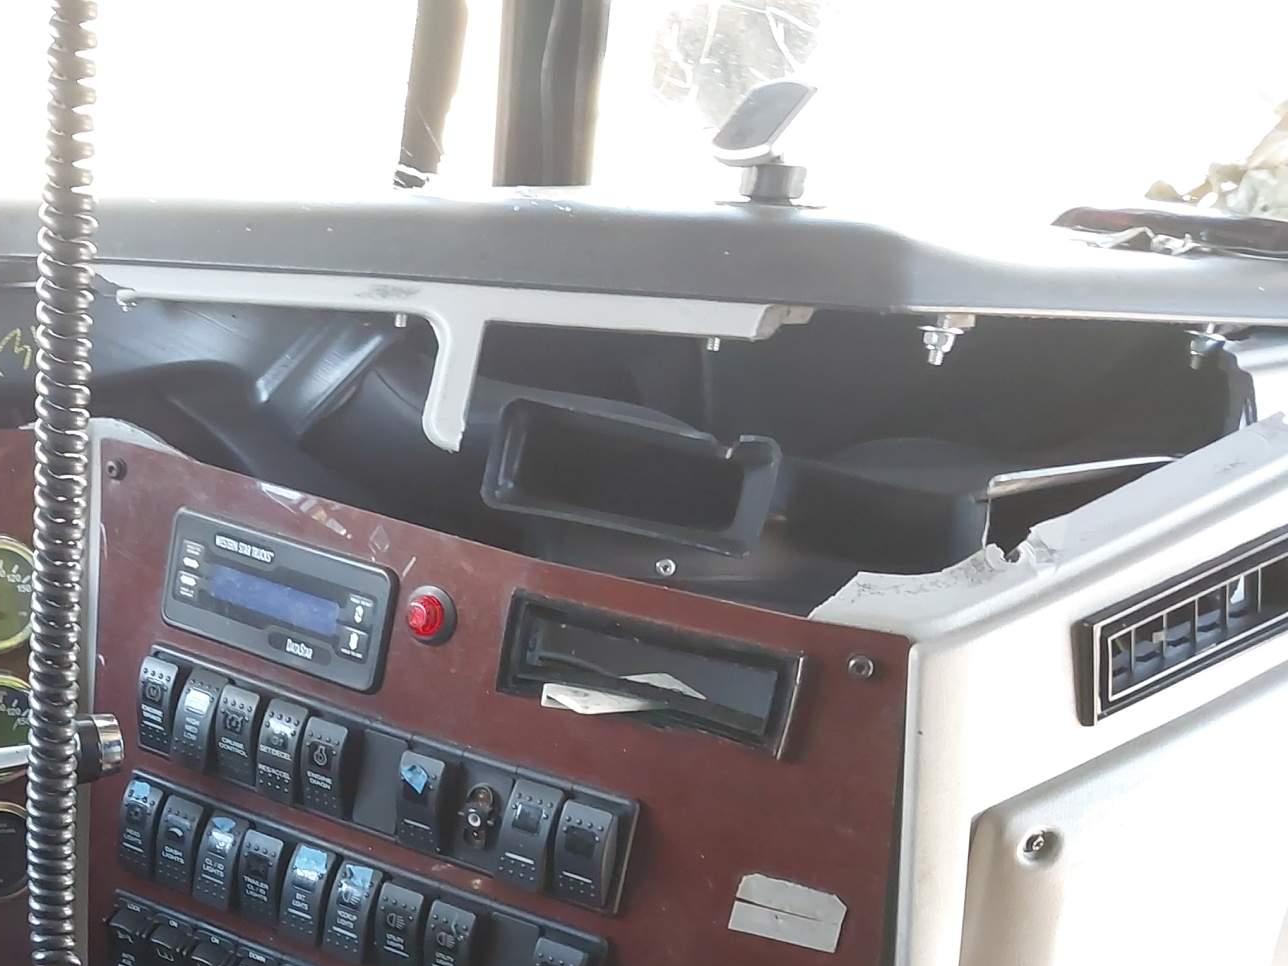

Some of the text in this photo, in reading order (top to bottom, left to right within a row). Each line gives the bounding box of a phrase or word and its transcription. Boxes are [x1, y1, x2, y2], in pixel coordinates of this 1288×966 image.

[218, 742, 248, 758] CONTROL
[221, 737, 245, 750] CRUISE
[307, 771, 333, 784] ENGINE
[162, 851, 185, 865] LIGHTS
[164, 846, 183, 857] DASH
[202, 864, 225, 878] LIGHTS
[242, 875, 269, 890] TRAILER
[248, 951, 266, 963] DOWN
